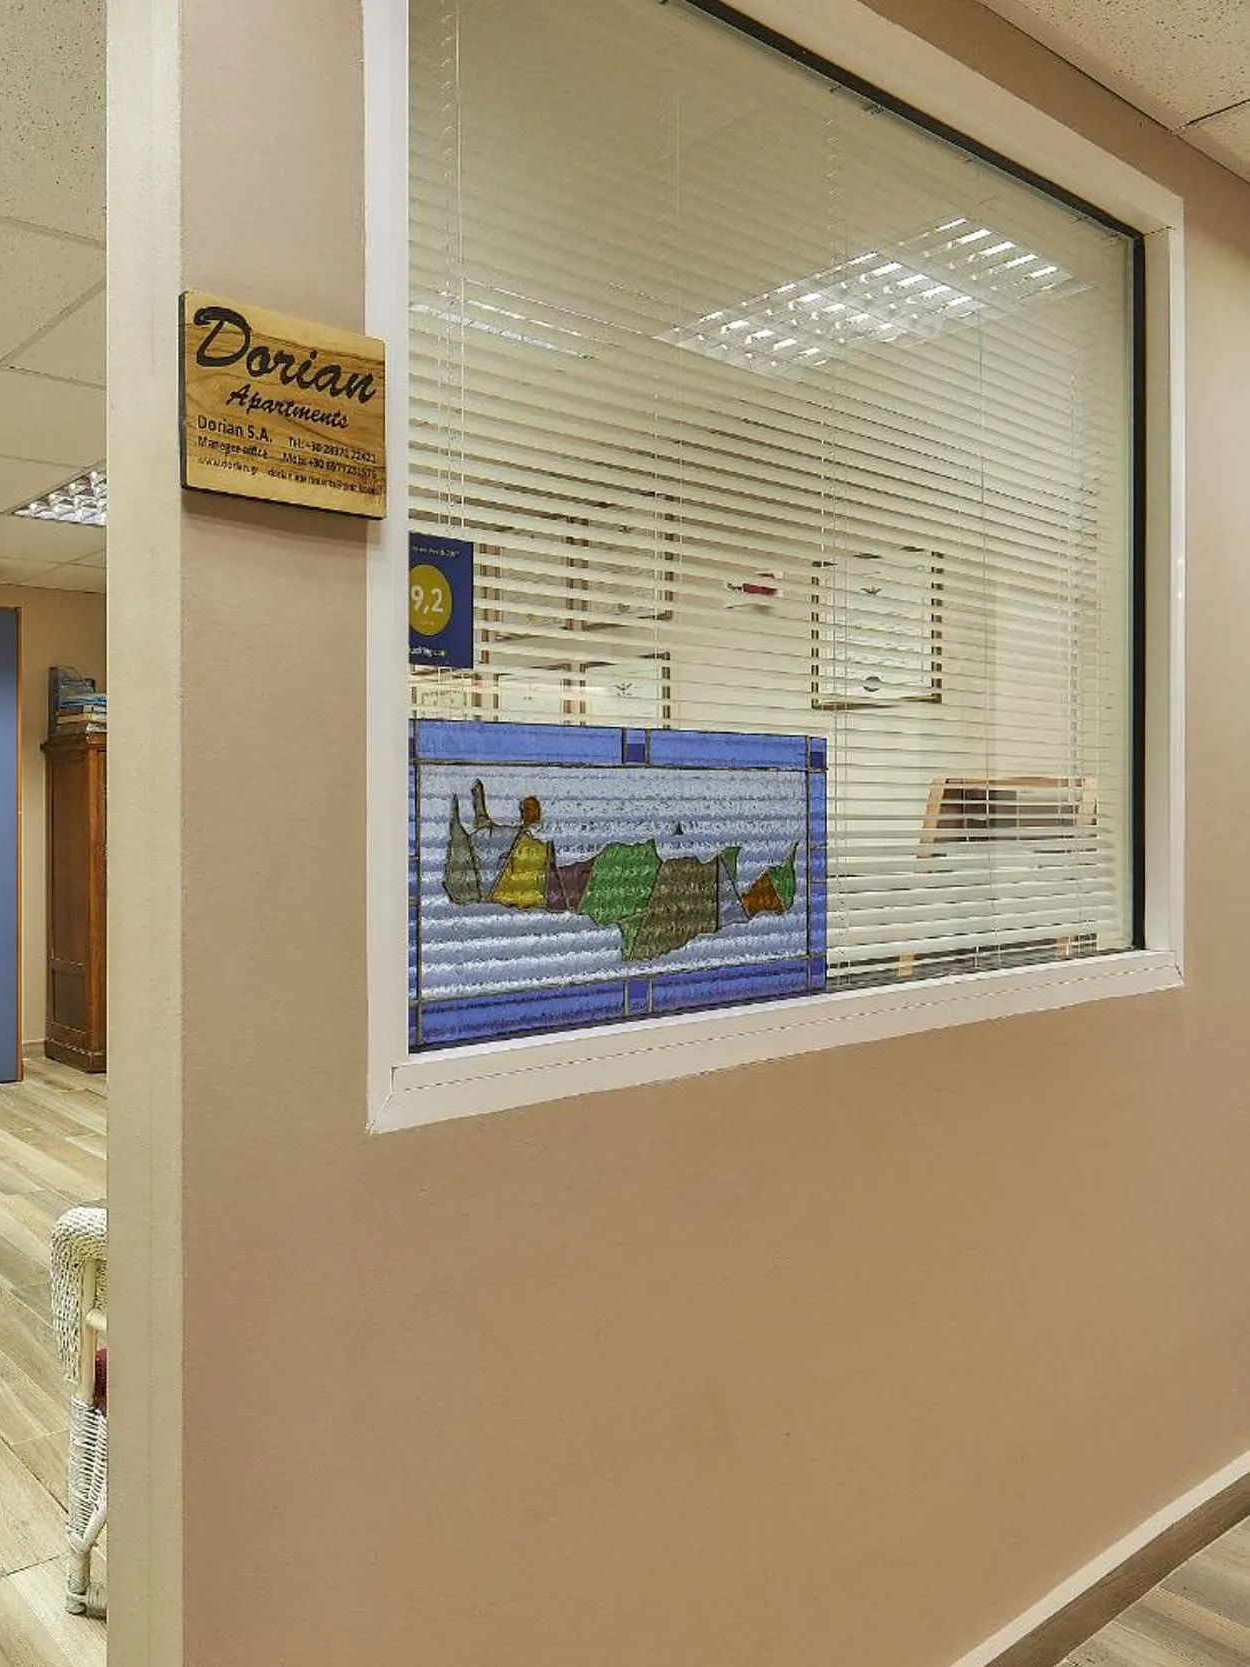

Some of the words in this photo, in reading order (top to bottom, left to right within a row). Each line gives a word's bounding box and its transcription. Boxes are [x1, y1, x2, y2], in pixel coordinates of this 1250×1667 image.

[193, 306, 377, 404] Dorian
[225, 383, 350, 429] Apartments
[197, 414, 243, 437] Dorian
[247, 424, 273, 442] S.A.
[411, 584, 444, 615] 9,2
